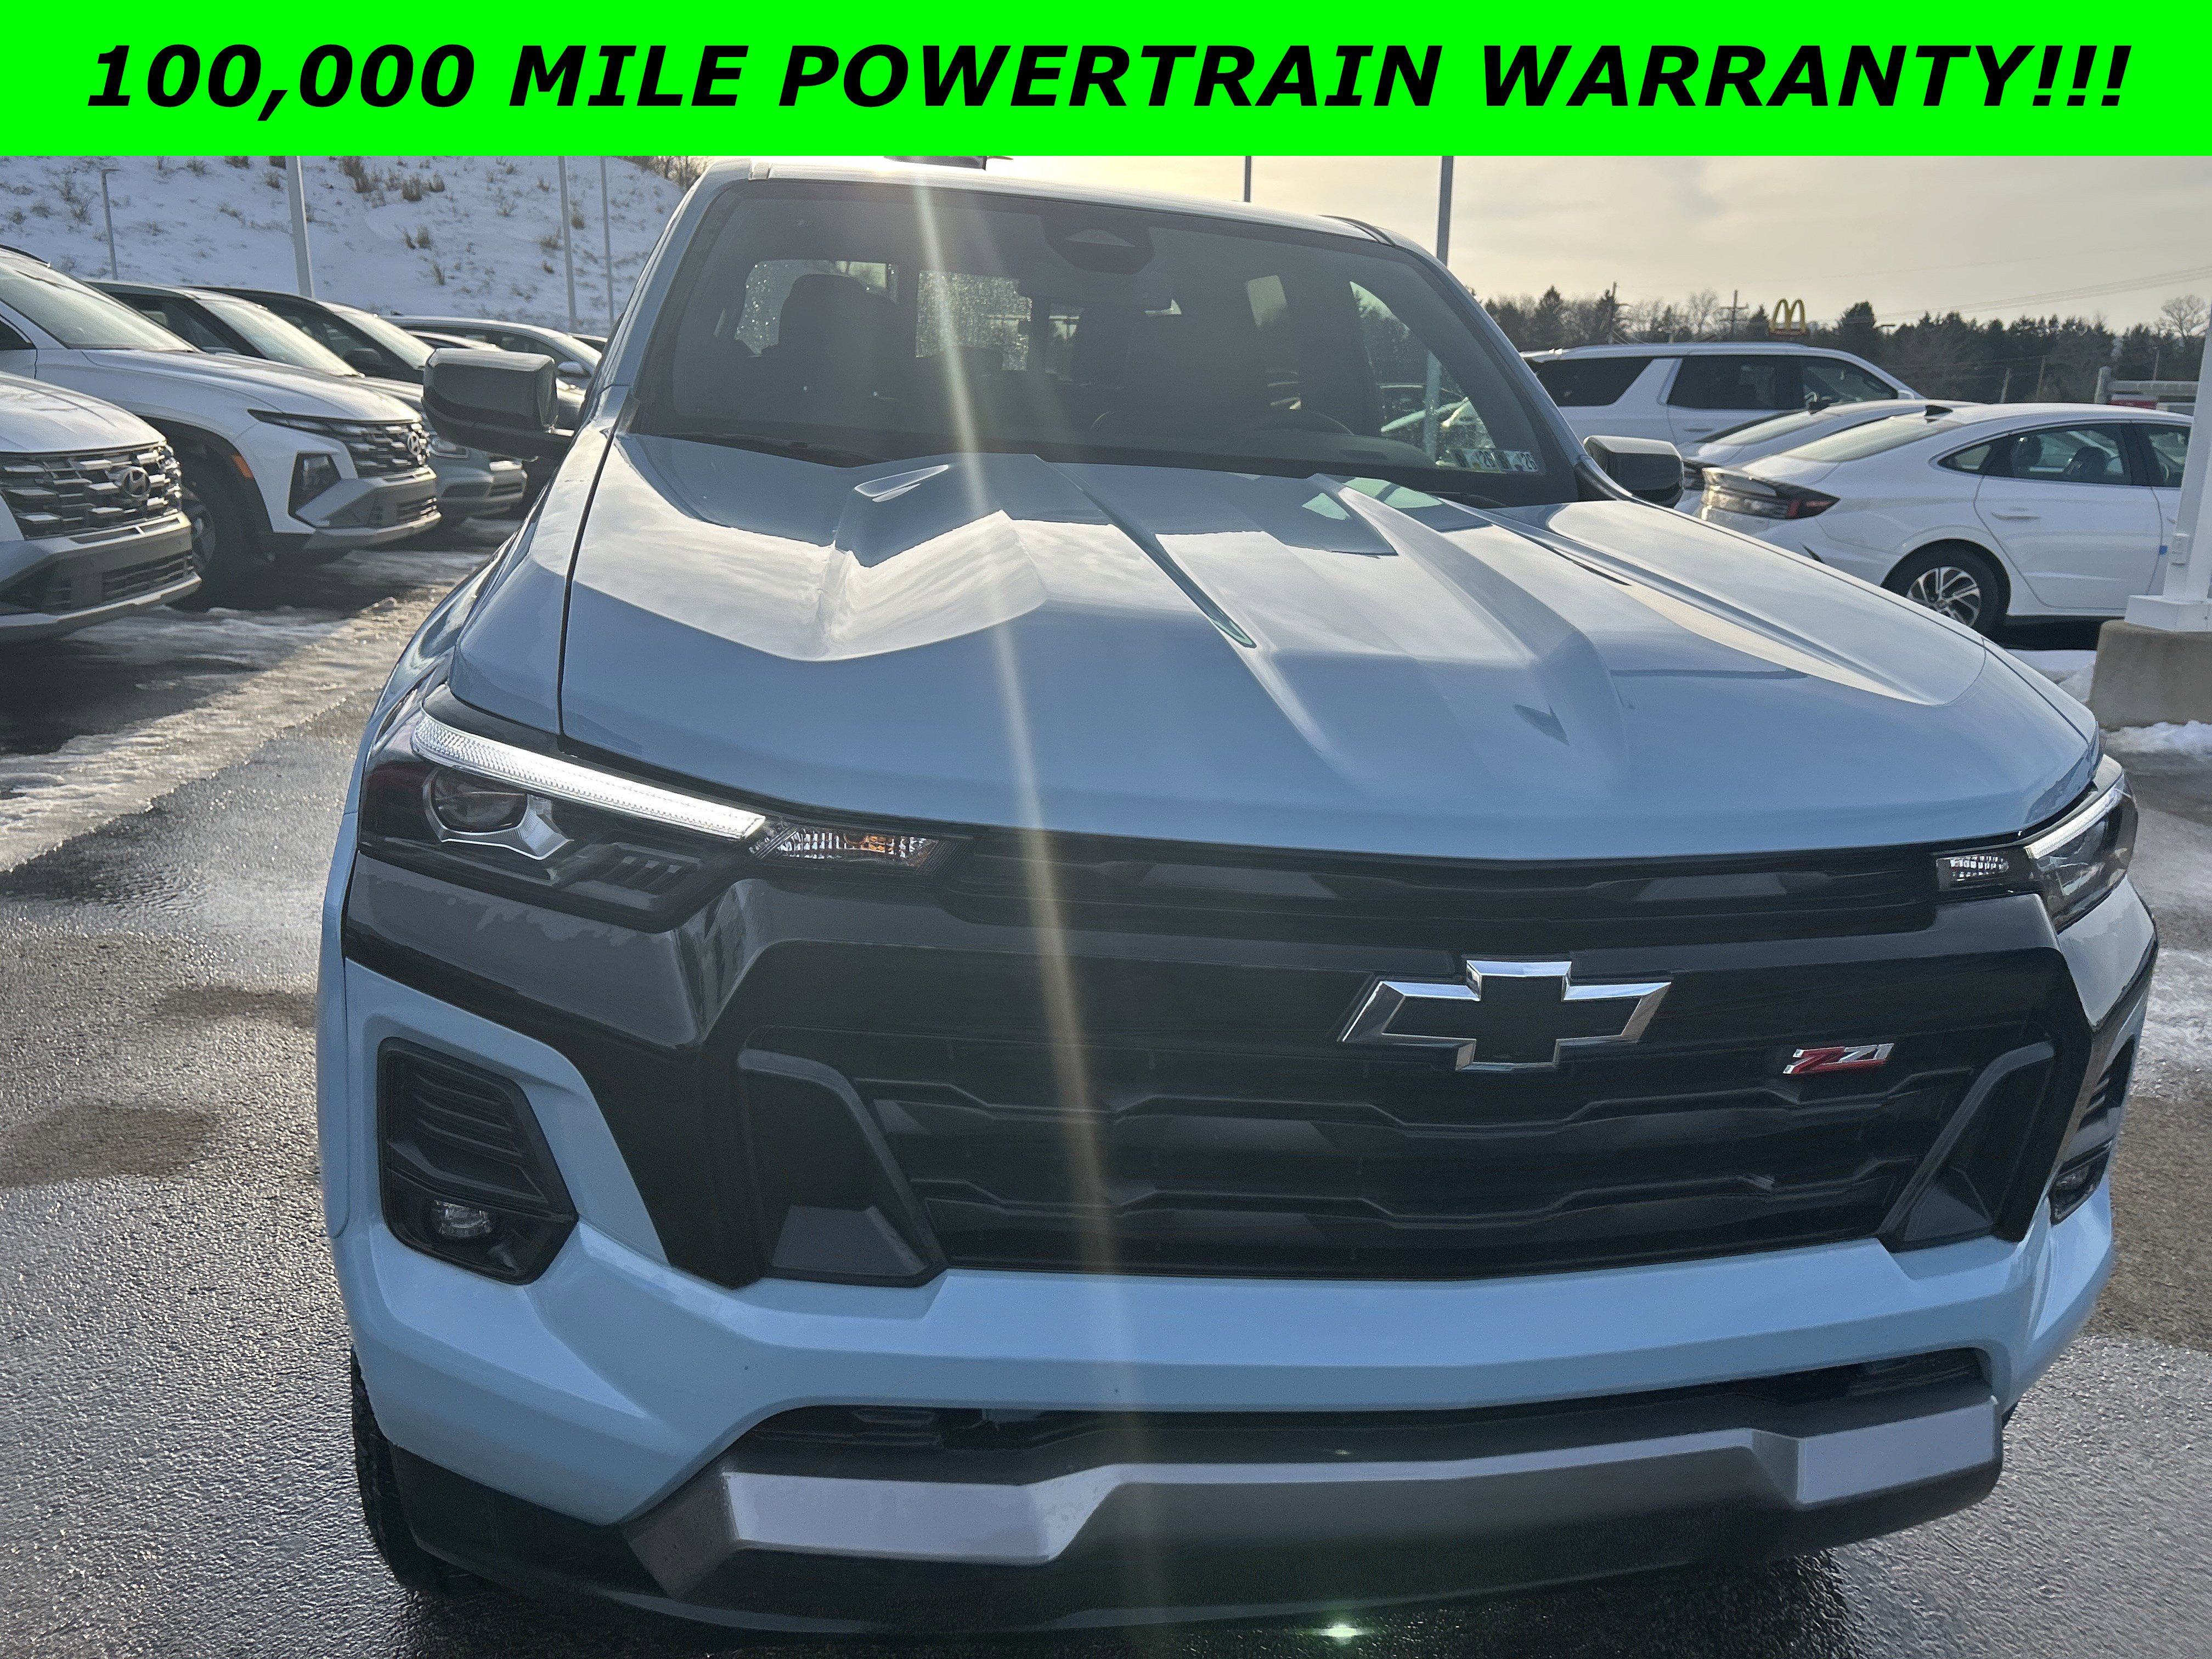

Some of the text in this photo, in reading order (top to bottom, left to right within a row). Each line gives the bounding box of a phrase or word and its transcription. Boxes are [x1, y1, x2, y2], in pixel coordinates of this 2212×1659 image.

[1478, 450, 1497, 467] 26
[1521, 453, 1538, 470] 26
[1782, 1043, 1894, 1074] Z71
